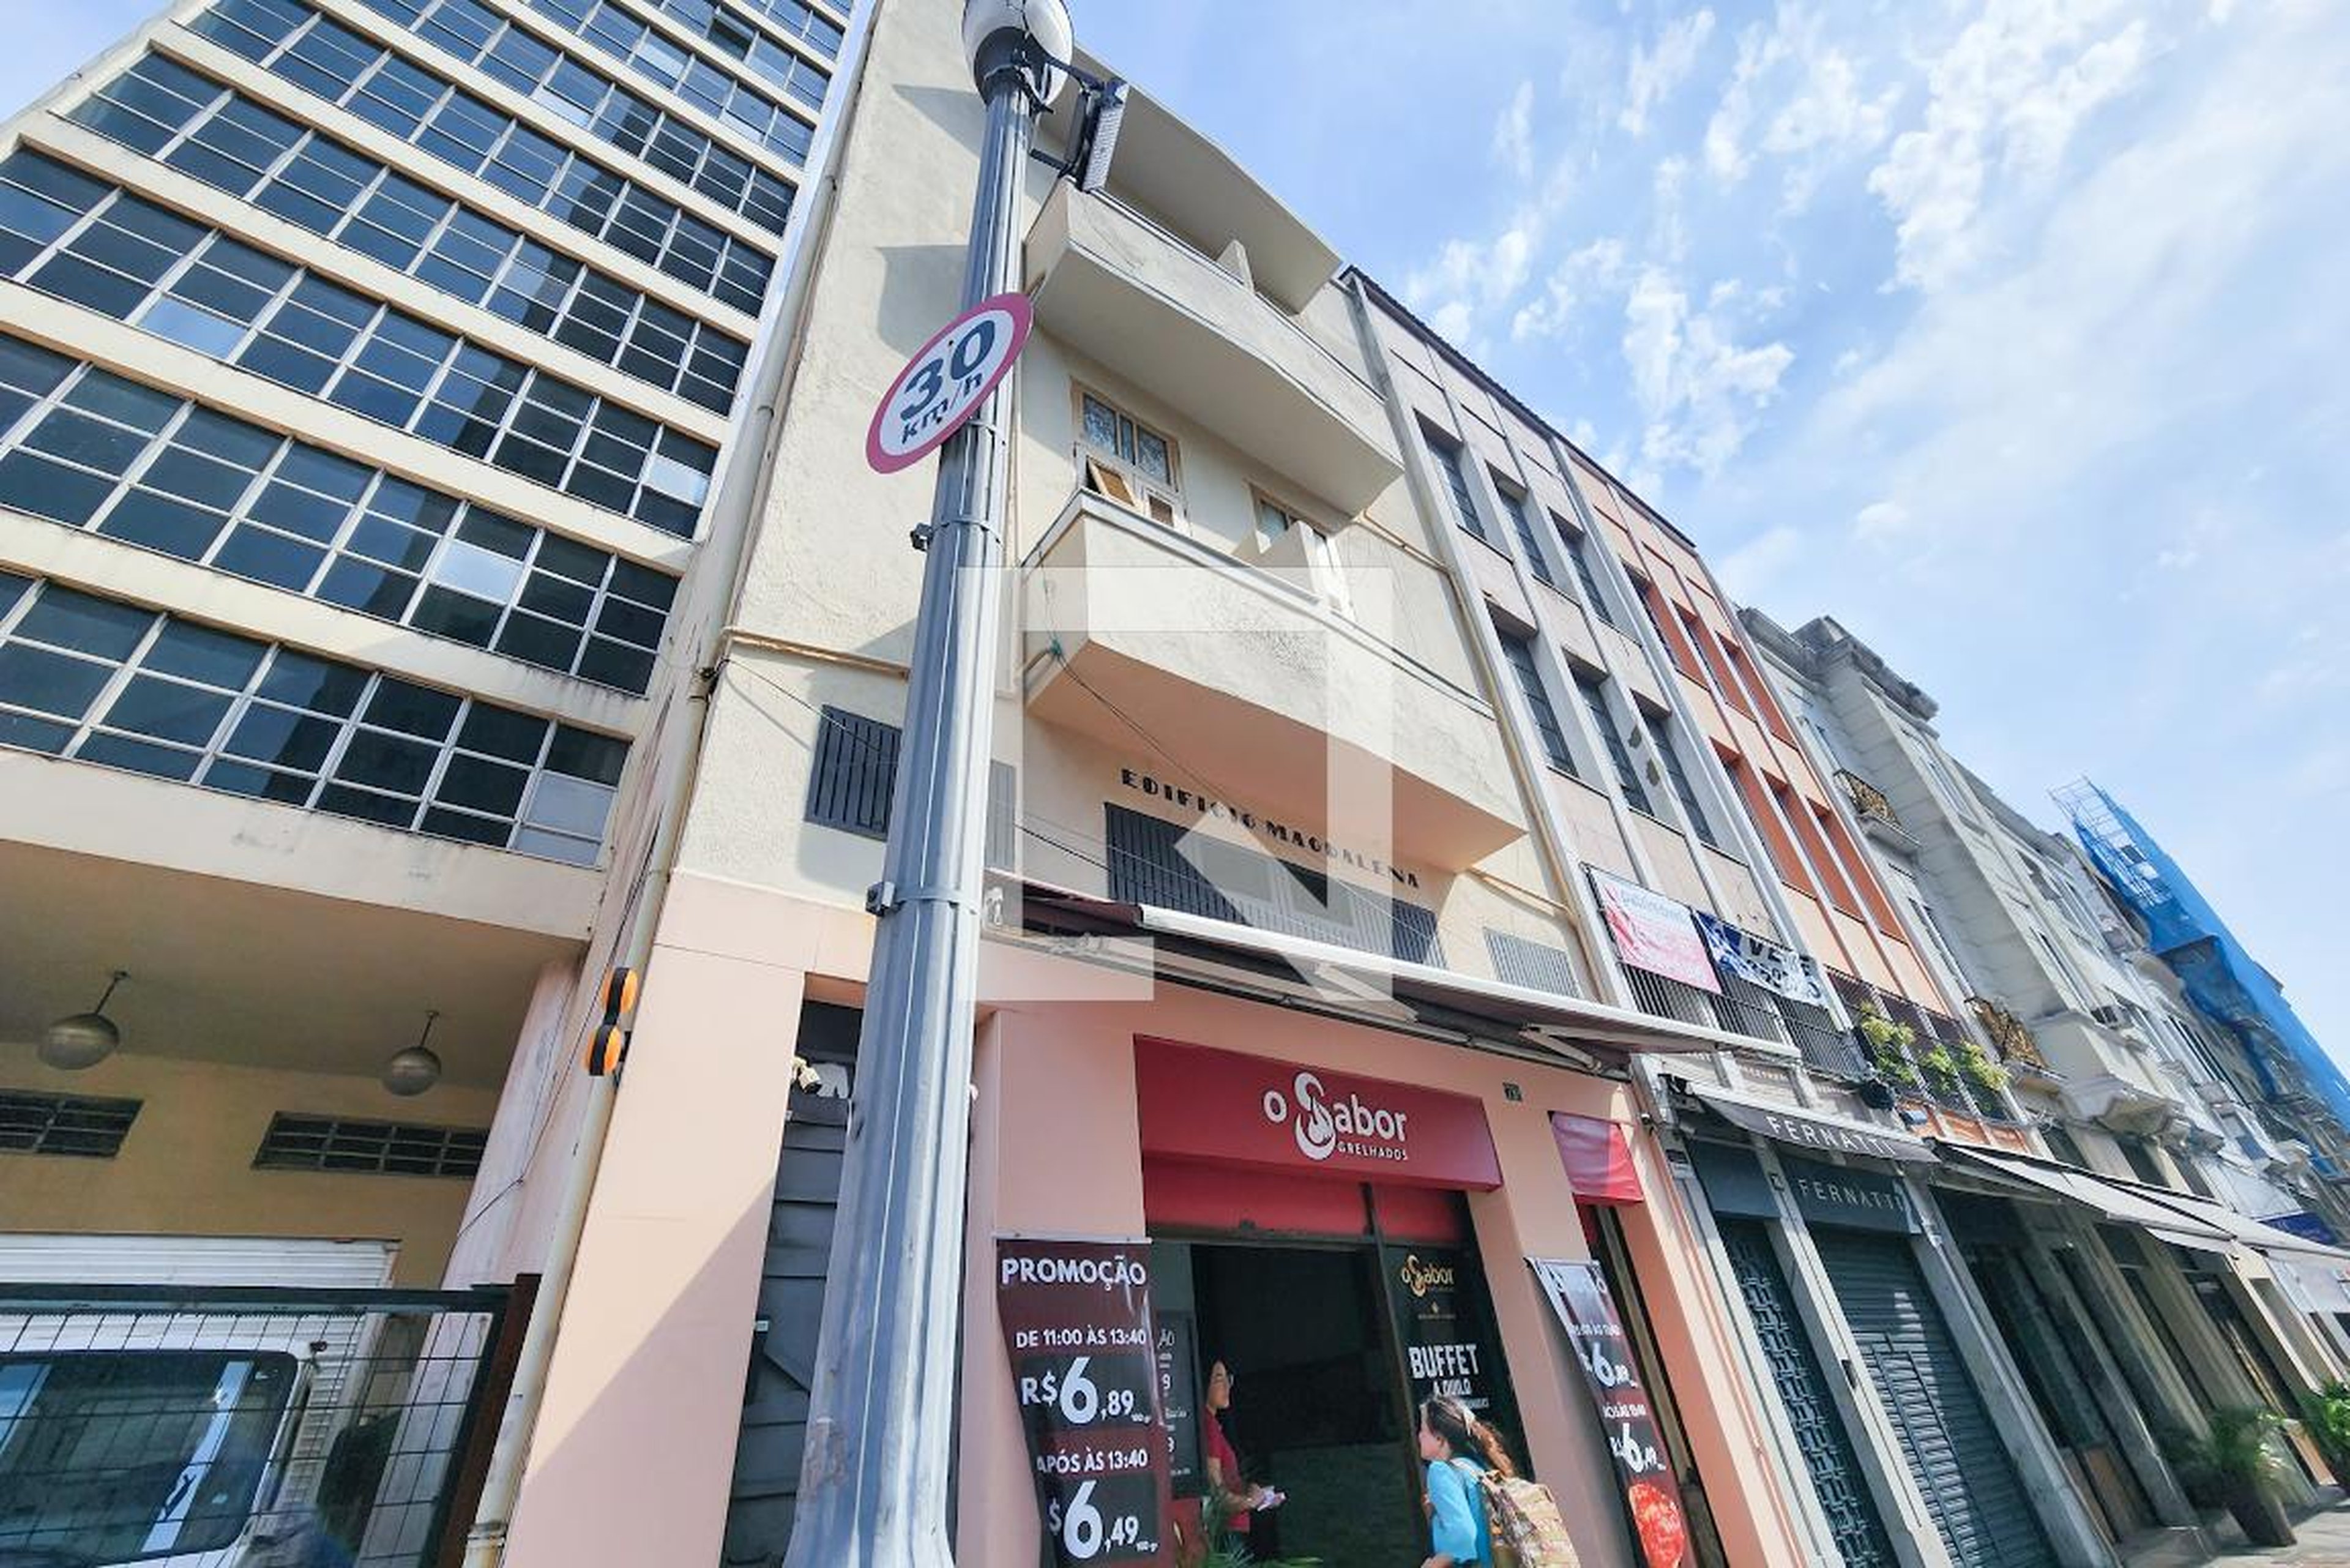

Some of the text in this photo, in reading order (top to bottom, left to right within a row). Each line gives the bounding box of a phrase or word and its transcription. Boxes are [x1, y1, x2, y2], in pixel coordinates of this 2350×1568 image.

[900, 320, 995, 420] 30
[901, 373, 982, 445] km/h
[1294, 1072, 1407, 1160] Sabor
[1338, 1141, 1408, 1161] GRELHADOS
[1766, 1116, 1897, 1156] FERNATTI
[1798, 1178, 1906, 1211] FERNATTI
[1001, 1255, 1146, 1291] PROMOÇÃO
[1016, 1331, 1039, 1348] DE
[1043, 1329, 1083, 1345] 11:00
[1086, 1324, 1107, 1345] ÀS
[1110, 1329, 1146, 1345] 13:40
[1408, 1343, 1479, 1378] BUFFET
[1037, 1446, 1148, 1474] APÓS ÀS 13:40
